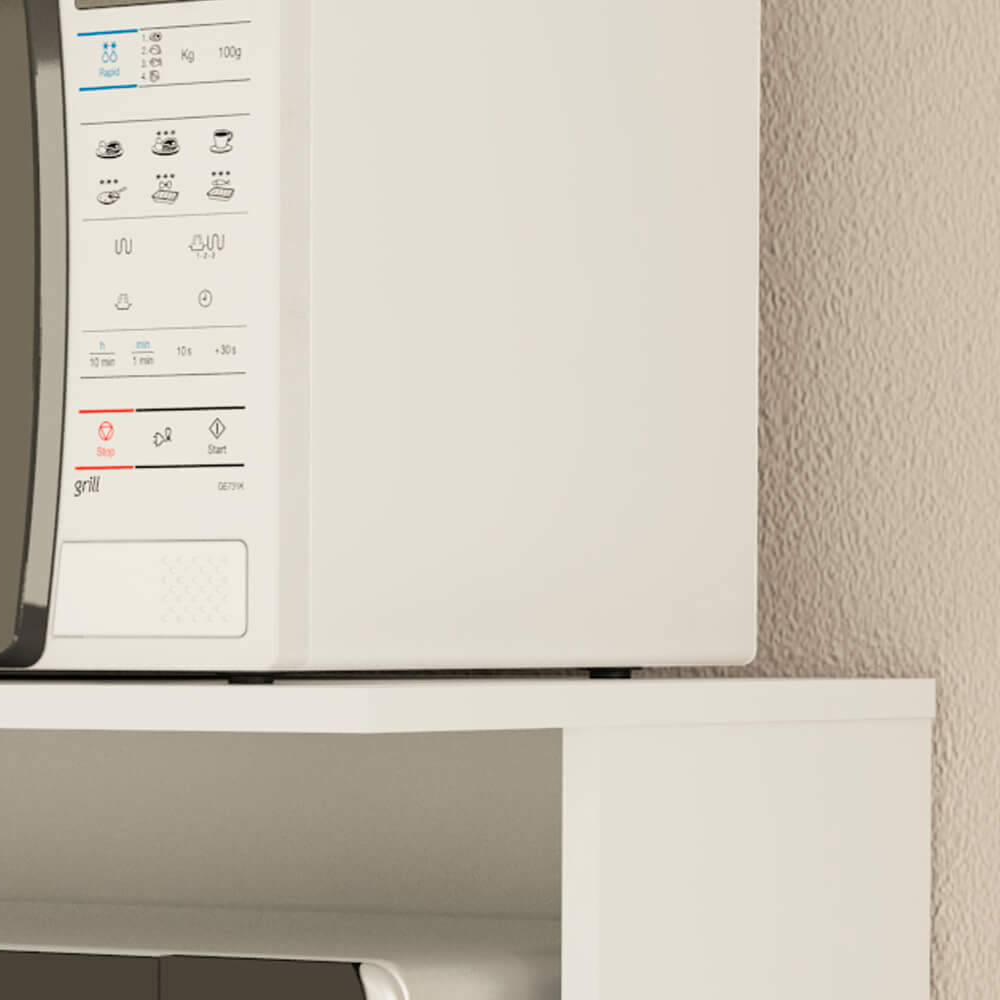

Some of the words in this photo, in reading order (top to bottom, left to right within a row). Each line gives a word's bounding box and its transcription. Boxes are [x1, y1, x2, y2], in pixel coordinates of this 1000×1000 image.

[181, 49, 195, 63] Kg
[218, 46, 242, 60] 100g
[98, 67, 120, 78] Rapid
[99, 340, 106, 350] h
[89, 357, 100, 368] 10
[101, 357, 116, 367] min
[139, 356, 154, 365] min
[96, 446, 116, 458] Stop
[207, 443, 228, 455] Start
[73, 476, 101, 497] grill
